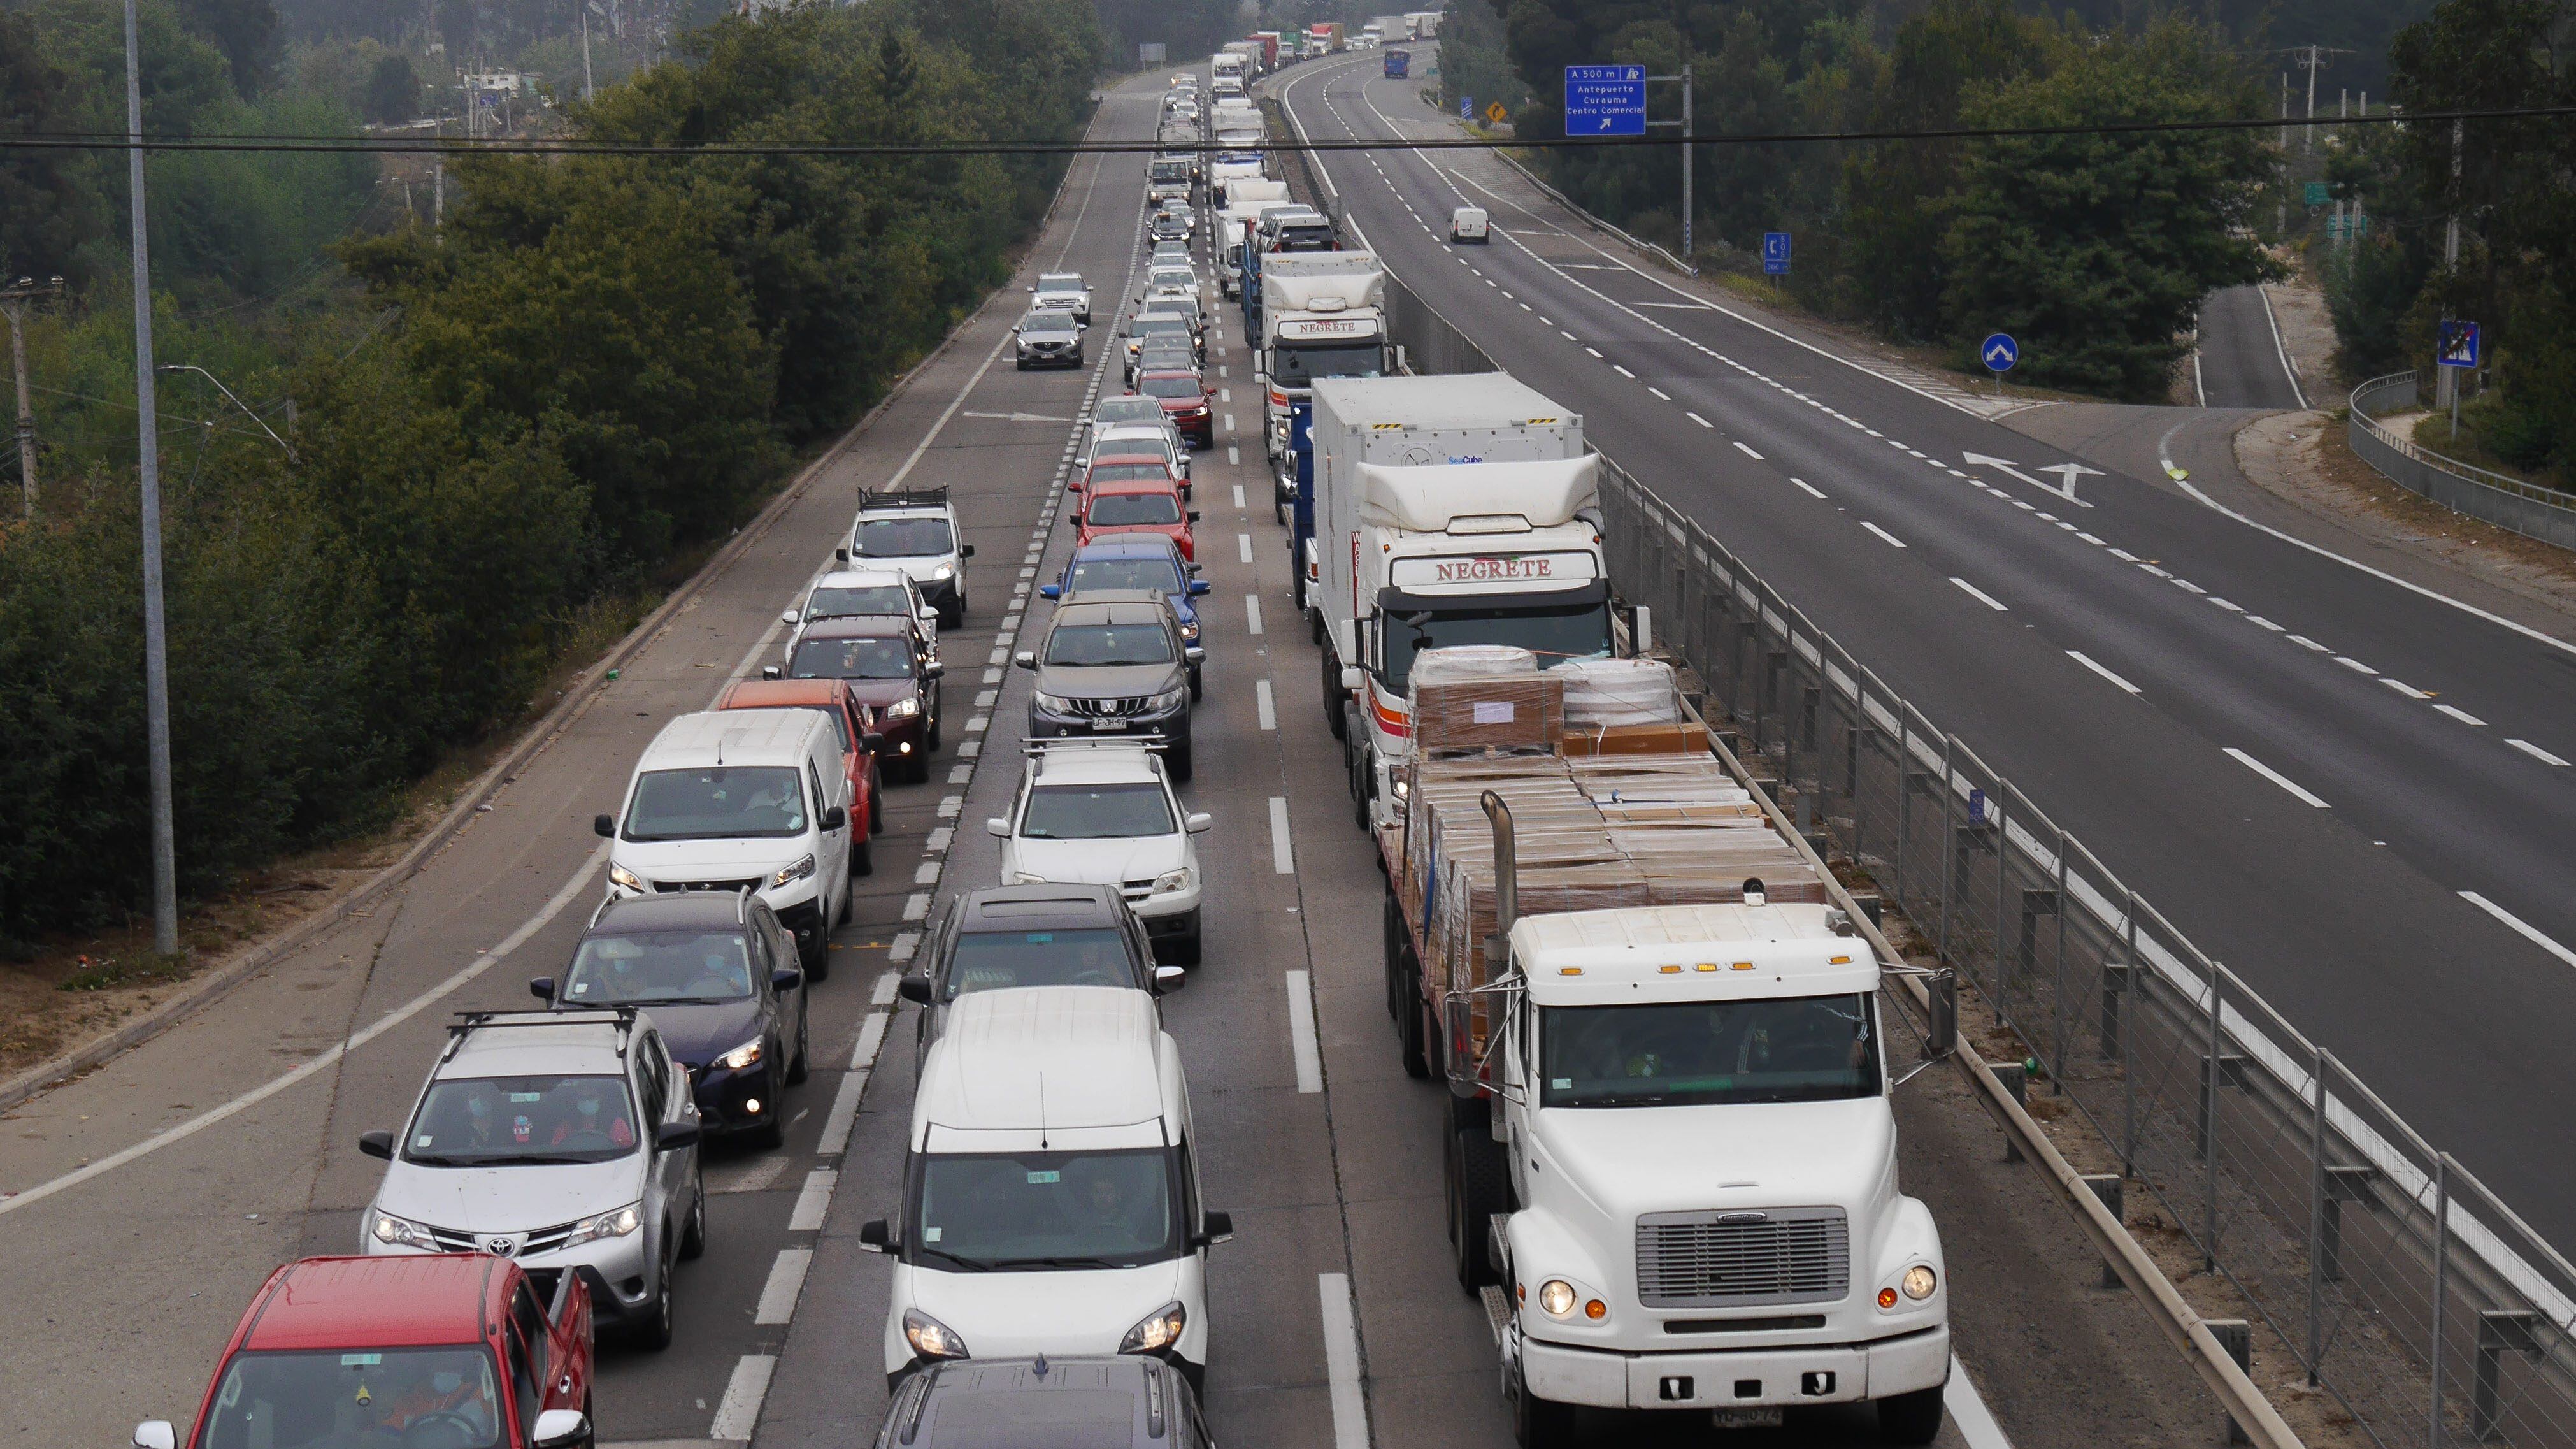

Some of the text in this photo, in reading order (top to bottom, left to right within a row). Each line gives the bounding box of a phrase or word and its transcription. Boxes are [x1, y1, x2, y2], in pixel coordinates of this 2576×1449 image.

[1584, 70, 1602, 78] 500
[1299, 322, 1356, 333] NEGRETE
[1447, 455, 1483, 465] SeaCube
[1436, 559, 1552, 582] NEGRETE
